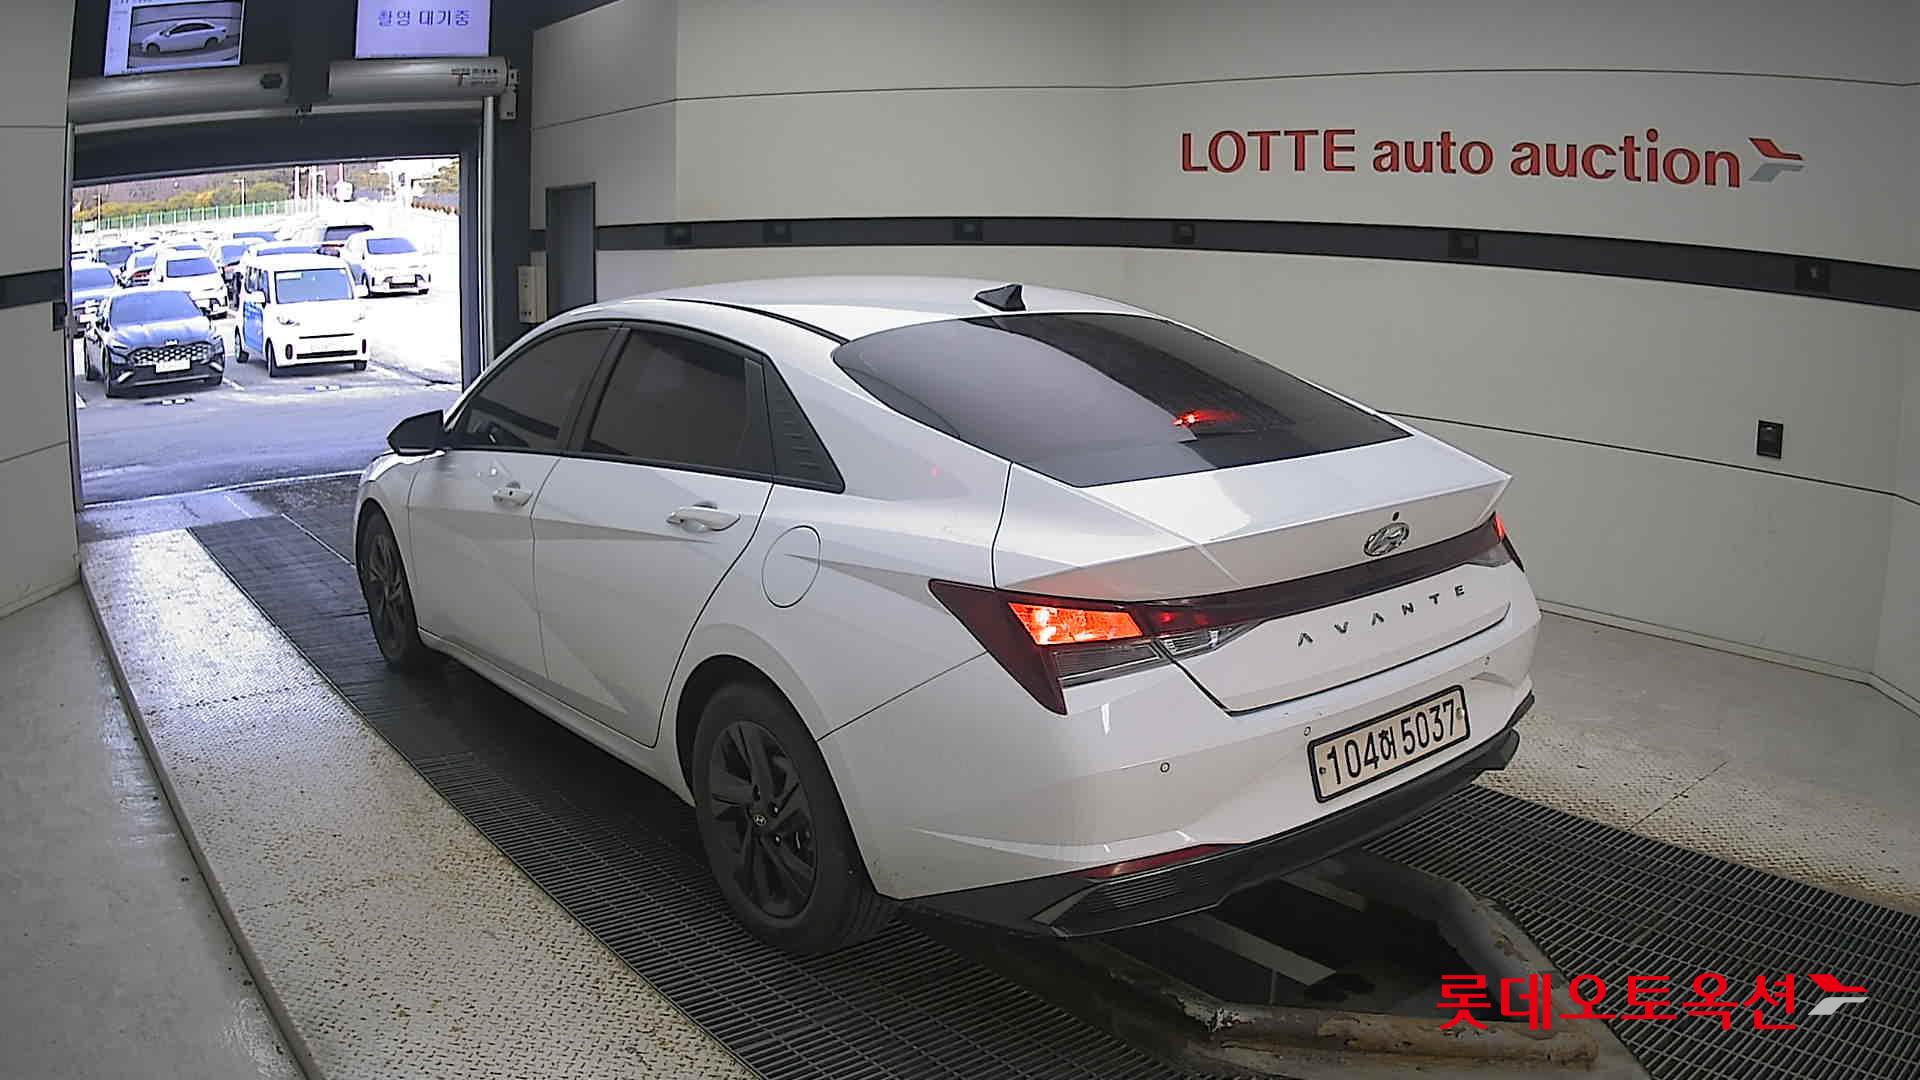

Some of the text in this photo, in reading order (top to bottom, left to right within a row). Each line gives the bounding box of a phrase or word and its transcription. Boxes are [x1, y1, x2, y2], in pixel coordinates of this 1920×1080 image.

[418, 9, 471, 27] 대기중
[1181, 128, 1741, 189] LOTTE auto auction
[1297, 585, 1465, 646] AVANTE
[1326, 699, 1455, 785] 104허 5037
